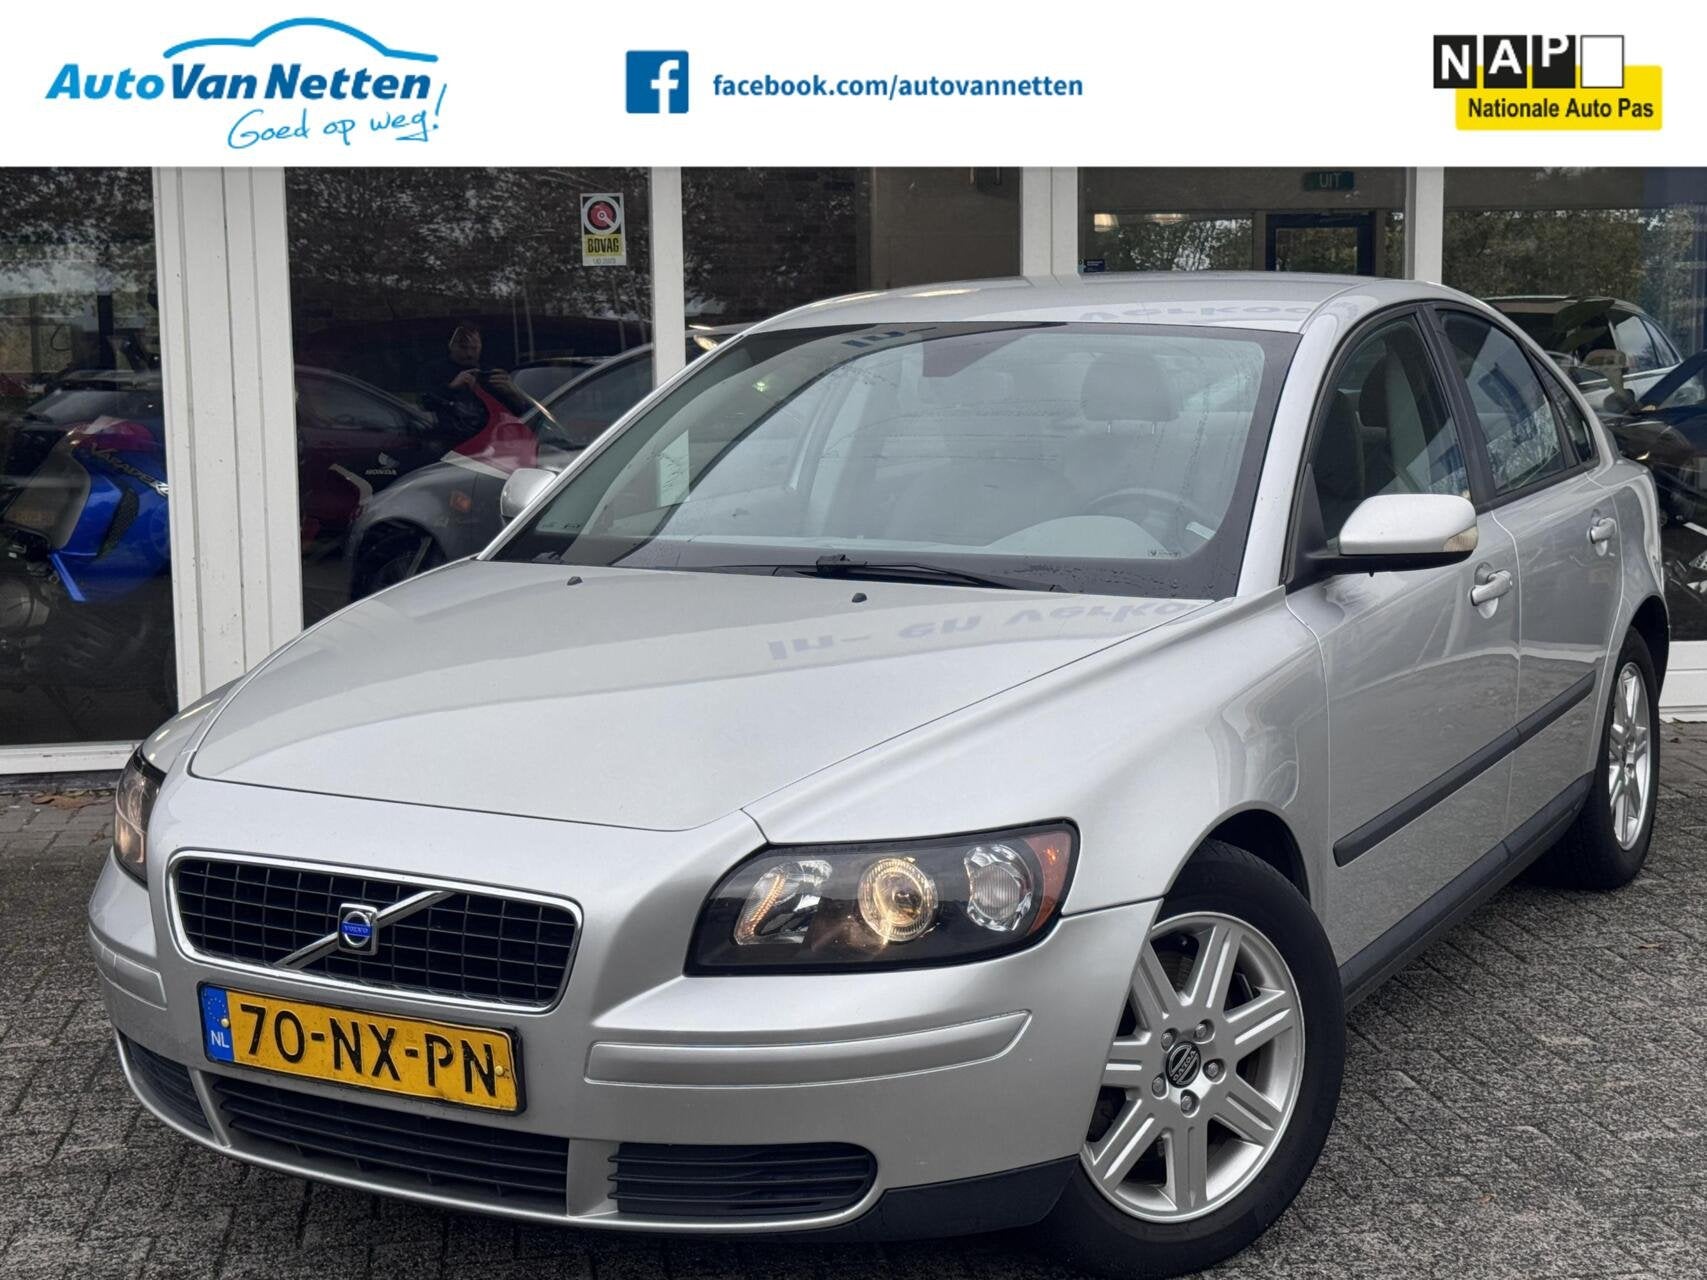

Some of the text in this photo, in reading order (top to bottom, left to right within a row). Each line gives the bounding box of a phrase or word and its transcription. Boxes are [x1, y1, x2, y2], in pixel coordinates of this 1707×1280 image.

[1319, 173, 1341, 188] UIT
[587, 238, 620, 253] BOVAG
[211, 1029, 230, 1049] NL
[239, 1003, 497, 1098] 70-NX-PN
